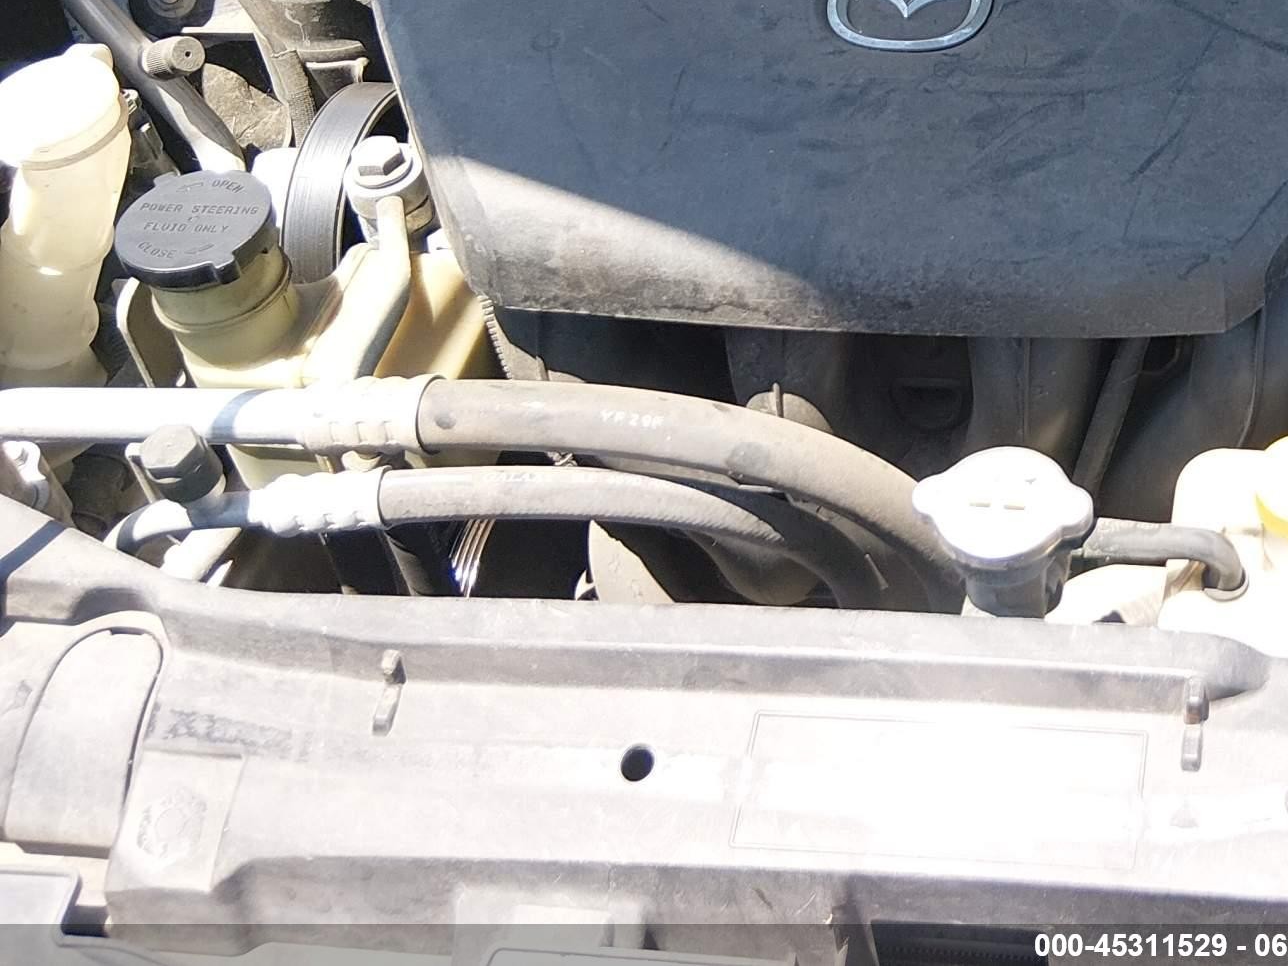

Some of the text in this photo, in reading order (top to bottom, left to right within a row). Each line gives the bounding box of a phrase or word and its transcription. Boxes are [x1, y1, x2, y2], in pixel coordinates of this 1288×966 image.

[211, 179, 244, 194] OPEN
[139, 202, 260, 215] POWER STEERING
[143, 221, 230, 234] FLUID ONLY
[137, 241, 177, 259] CLOSE
